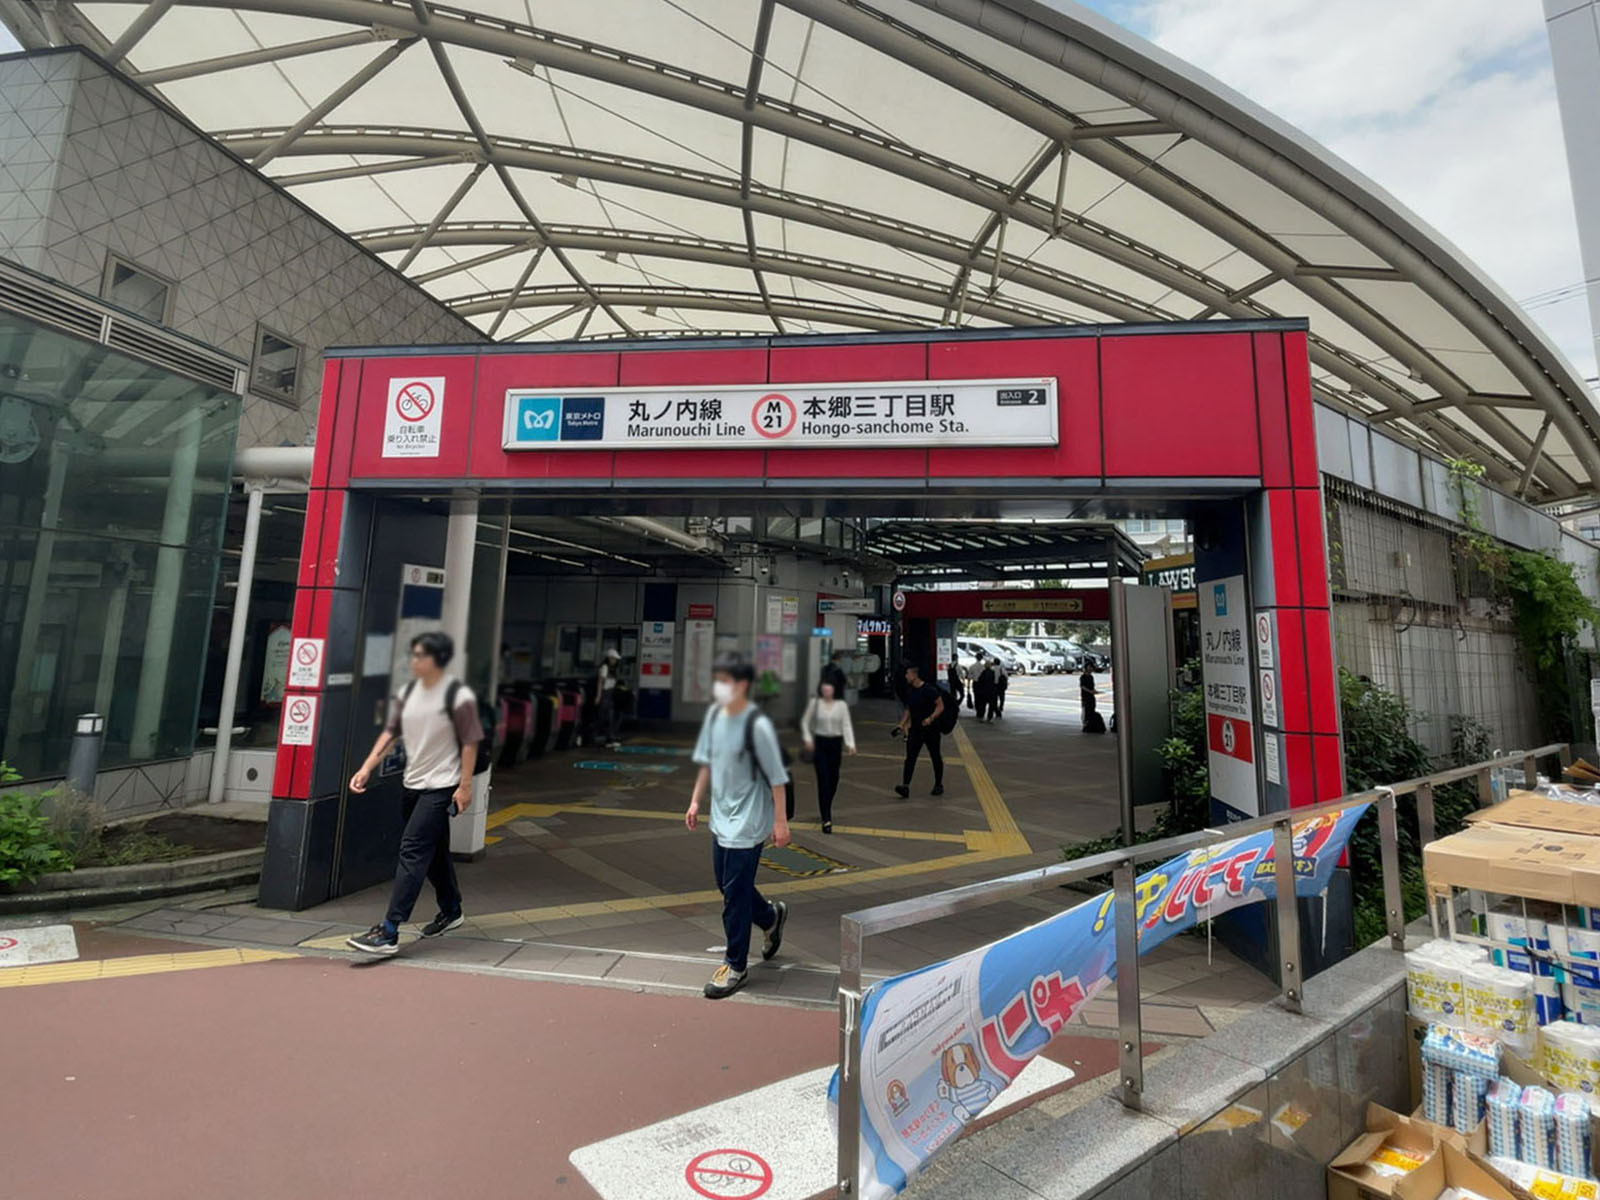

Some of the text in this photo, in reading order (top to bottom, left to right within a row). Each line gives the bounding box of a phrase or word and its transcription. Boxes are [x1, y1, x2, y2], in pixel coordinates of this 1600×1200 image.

[1028, 390, 1039, 404] 2
[628, 399, 723, 422] 丸ノ内線
[767, 401, 782, 413] M
[803, 394, 955, 419] 本郷三丁目駅
[566, 412, 602, 420] 東京メトロ
[763, 415, 782, 428] 21
[399, 425, 425, 434] 自転車
[628, 422, 746, 437] Marunouchi Line
[802, 419, 969, 438] Hongo-sanchome Sta.
[387, 434, 437, 443] 乗り入れ禁止
[1206, 628, 1242, 652] 丸ノ内線
